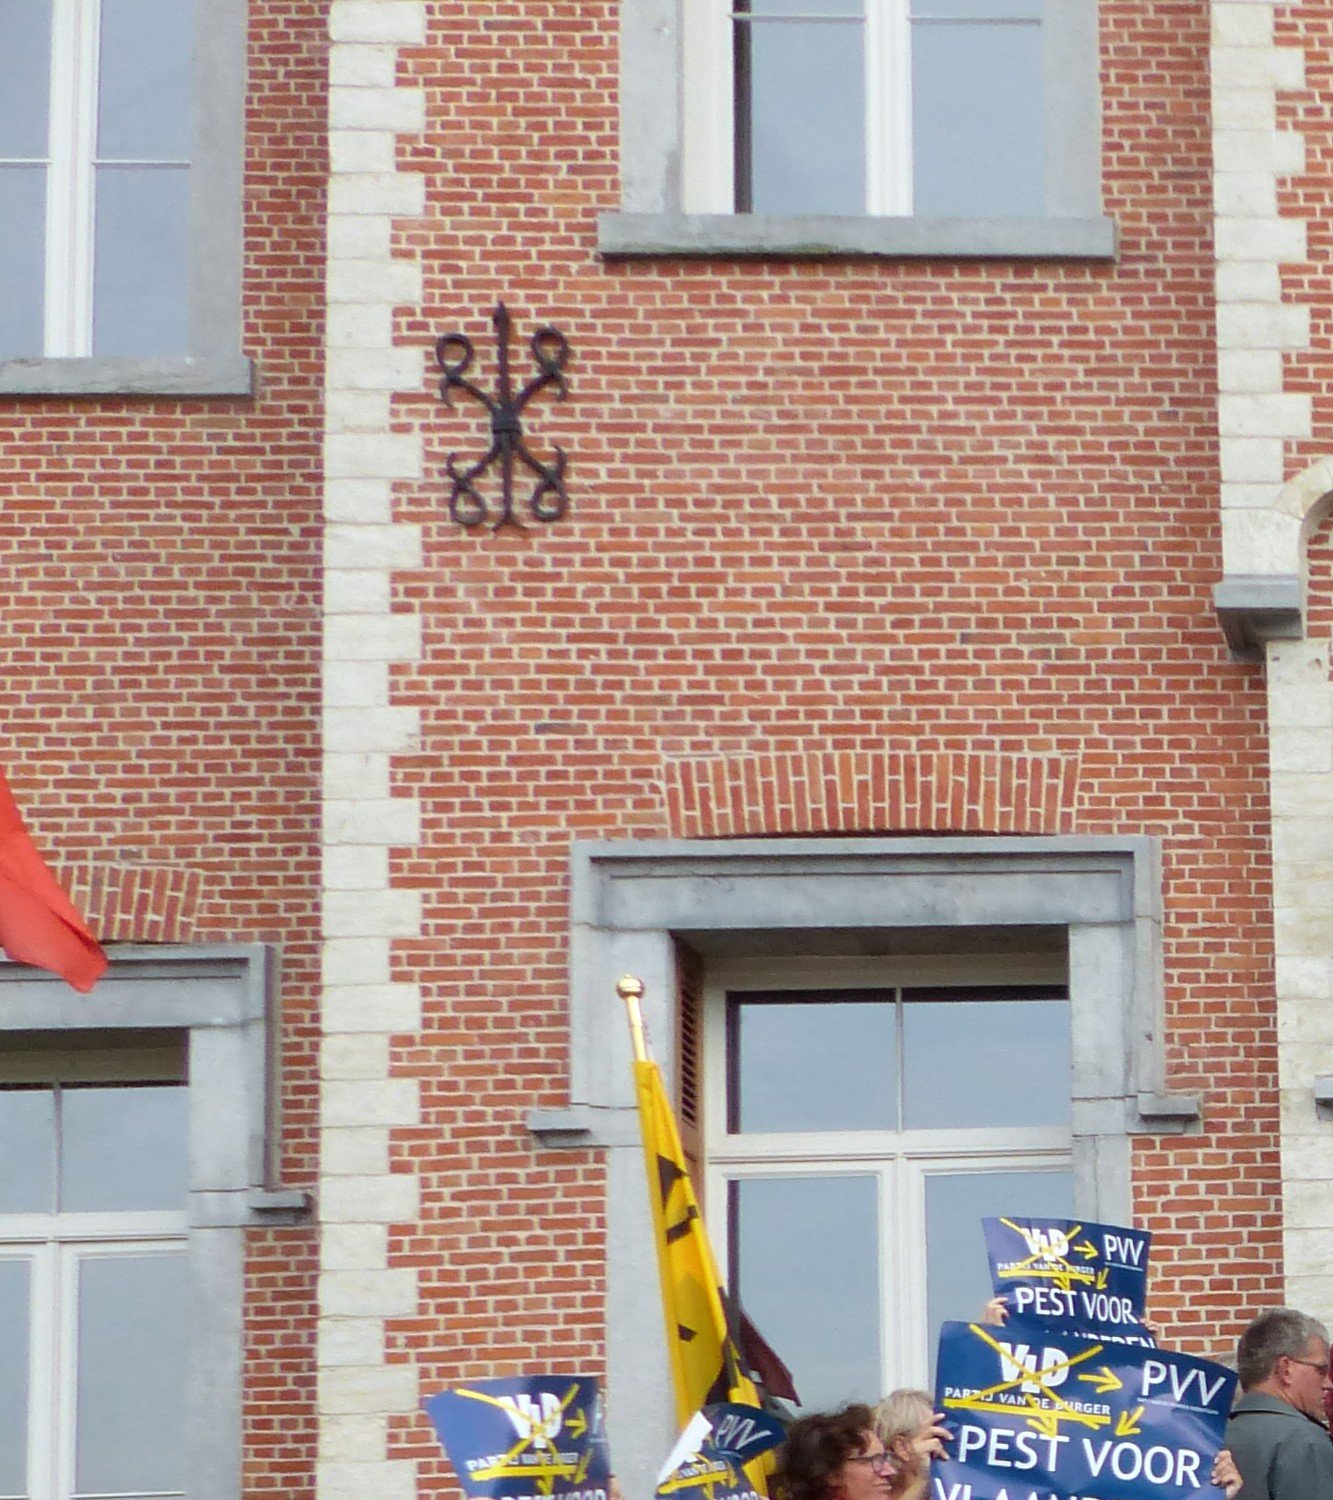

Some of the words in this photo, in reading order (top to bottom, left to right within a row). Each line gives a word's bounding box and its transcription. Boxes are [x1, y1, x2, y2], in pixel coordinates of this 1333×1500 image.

[1103, 1234, 1145, 1266] PVV
[1015, 1287, 1077, 1317] PEST
[1081, 1291, 1138, 1324] VOOR
[996, 1394, 1026, 1405] VAN
[1140, 1359, 1226, 1406] PVV
[715, 1414, 773, 1450] PVV
[958, 1424, 1070, 1472] PEST
[1083, 1438, 1200, 1488] VOOR
